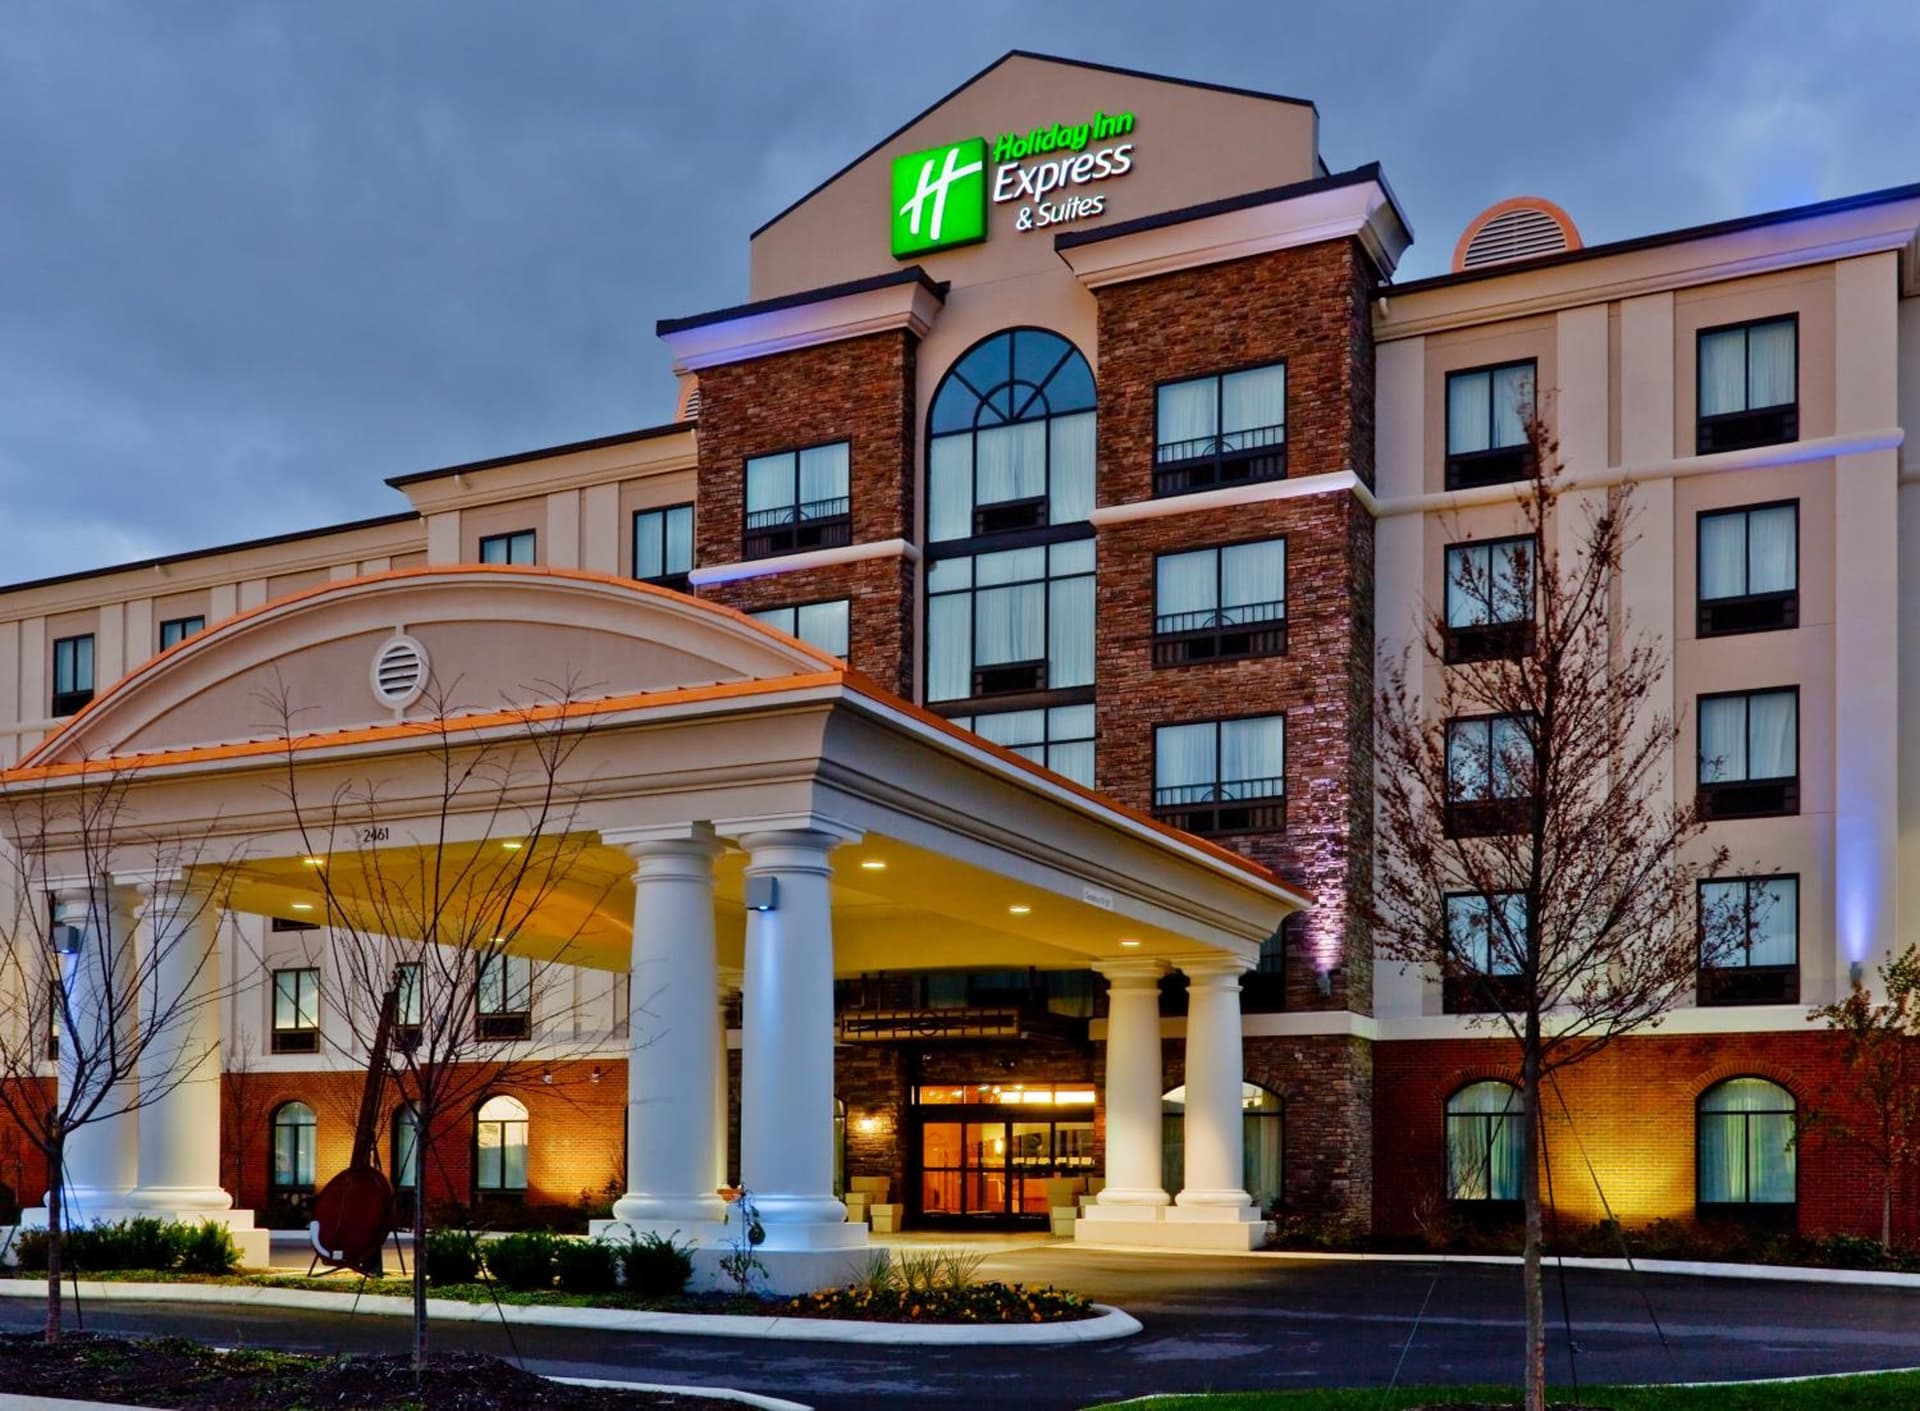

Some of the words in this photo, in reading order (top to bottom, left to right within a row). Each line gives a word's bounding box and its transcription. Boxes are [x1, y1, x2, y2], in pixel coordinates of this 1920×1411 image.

[993, 123, 1088, 162] Holiday
[1092, 111, 1135, 140] Inn
[993, 144, 1133, 202] Express
[1016, 207, 1032, 231] &
[1036, 194, 1105, 226] Suites
[363, 827, 389, 842] 2461
